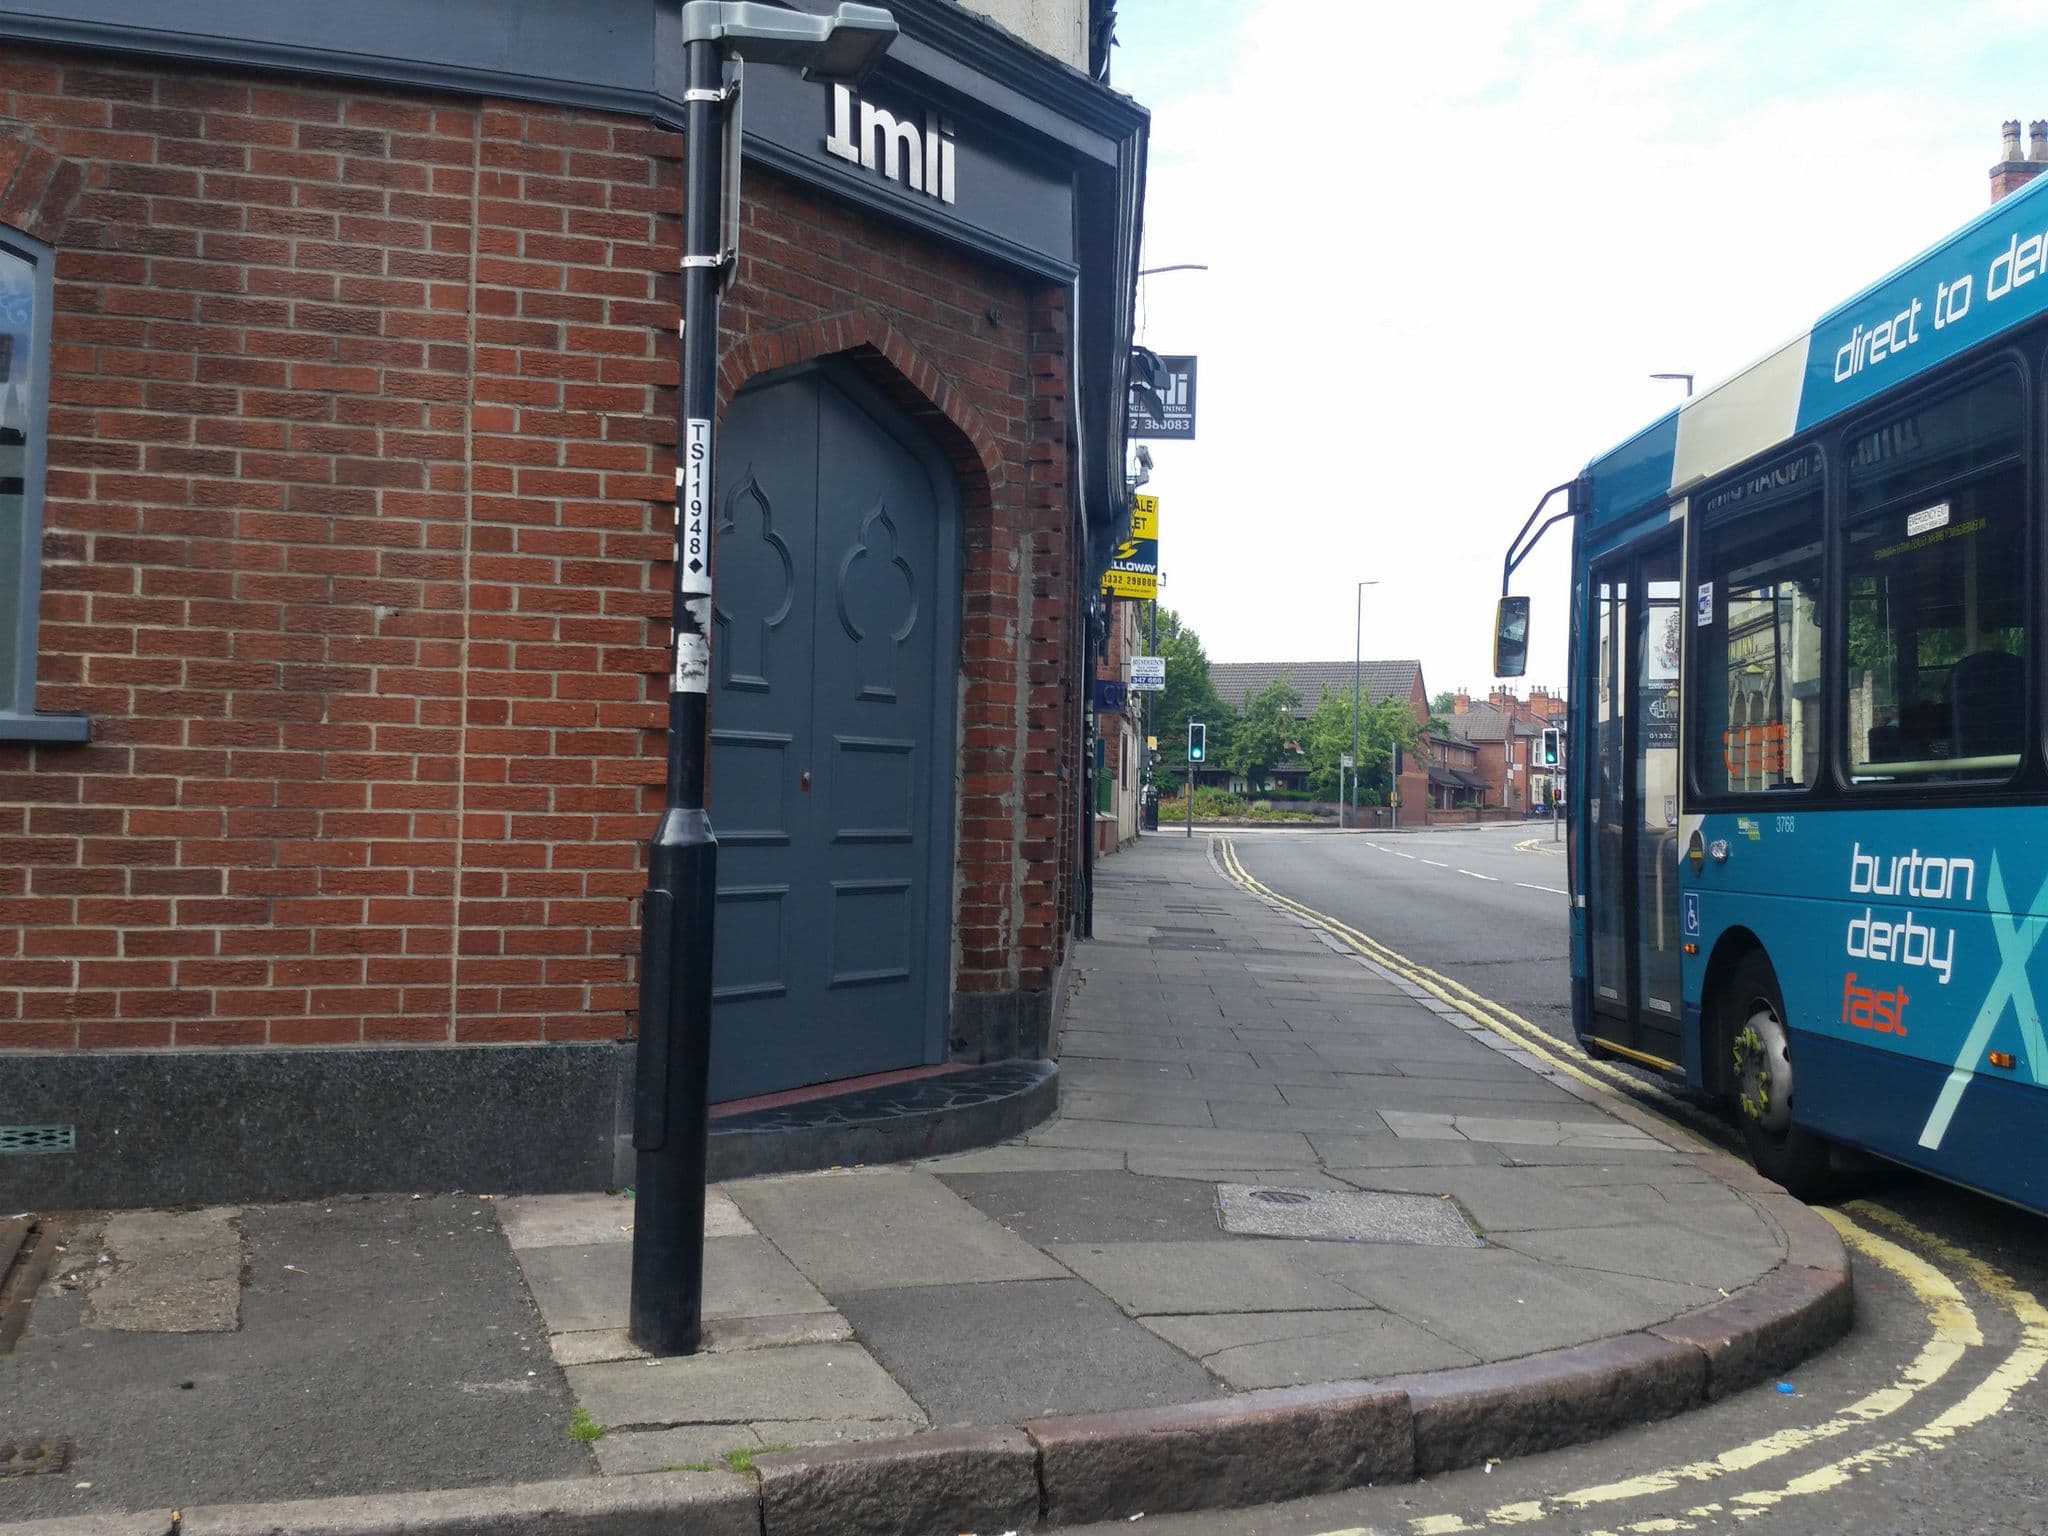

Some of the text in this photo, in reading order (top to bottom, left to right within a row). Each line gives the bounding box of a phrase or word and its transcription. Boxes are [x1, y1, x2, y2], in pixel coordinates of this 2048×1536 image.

[827, 83, 955, 205] Imli
[1834, 298, 1922, 383] direct
[1934, 275, 1973, 330] to
[1145, 419, 1190, 430] 380083
[690, 424, 704, 555] TS11948
[1111, 561, 1156, 574] LLOWAY
[1776, 816, 1795, 833] 3768
[1850, 842, 1974, 900] burton
[1847, 908, 1955, 984] derby
[1842, 972, 1909, 1036] fast
